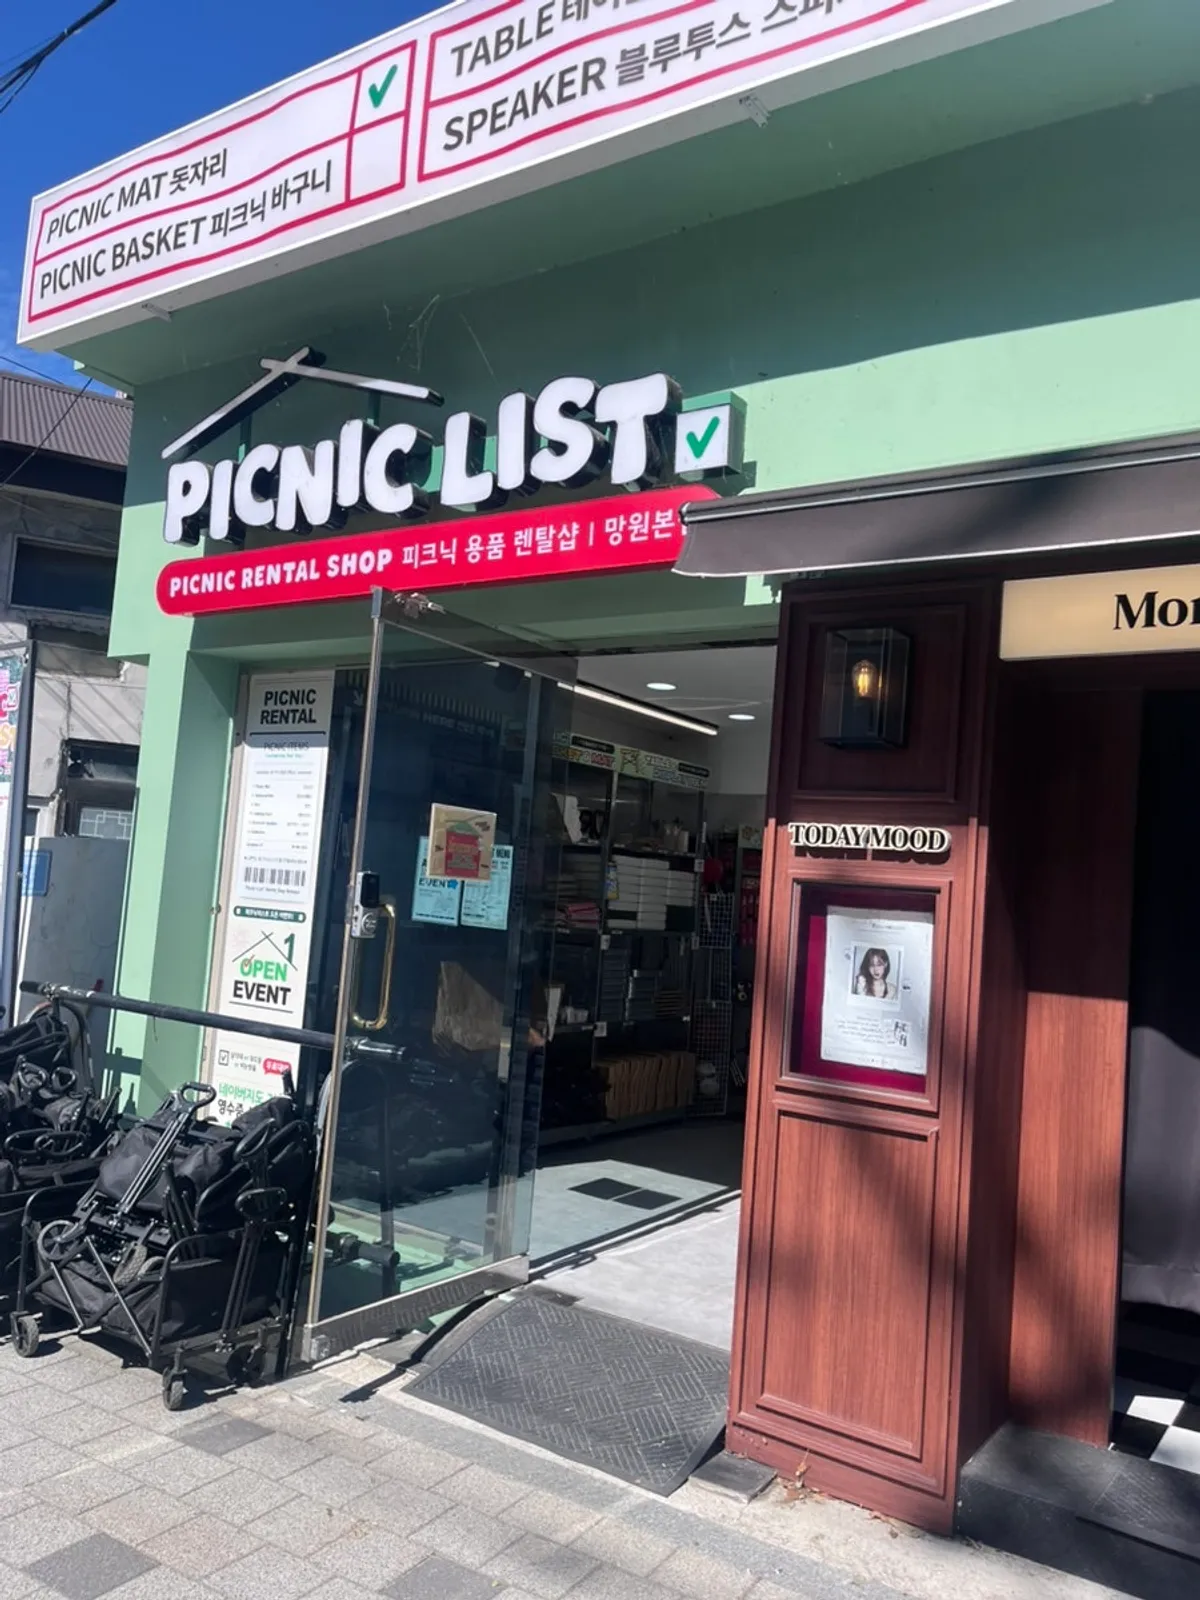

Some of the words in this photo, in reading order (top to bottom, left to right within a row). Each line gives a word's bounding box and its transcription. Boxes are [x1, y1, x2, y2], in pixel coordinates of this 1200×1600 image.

[450, 2, 555, 78] TABLE
[443, 57, 607, 152] SPEAKER
[615, 11, 752, 87] 블루투스
[46, 191, 115, 244] PICNIC
[117, 171, 169, 213] MAT
[169, 148, 228, 195] 돗자리
[40, 249, 106, 299] PICNIC
[112, 216, 206, 271] BASKET
[210, 191, 266, 237] 피크닉
[271, 160, 332, 213] 바구니
[163, 419, 418, 543] PICNIC
[441, 373, 668, 506] LIST
[170, 570, 235, 598] PICNIC
[241, 559, 320, 589] RENTAL
[327, 549, 392, 577] SHOP
[402, 538, 457, 569] 피크닉
[465, 532, 506, 563] 용품
[513, 523, 579, 557] 렌탈샵
[604, 509, 687, 546] 망원본
[260, 709, 317, 725] RENTAL
[264, 689, 317, 706] PICNIC
[790, 824, 868, 847] TODAY
[870, 826, 947, 851] MOOD
[240, 957, 288, 982] OPEN
[284, 933, 296, 964] 1
[233, 980, 291, 1006] EVENT
